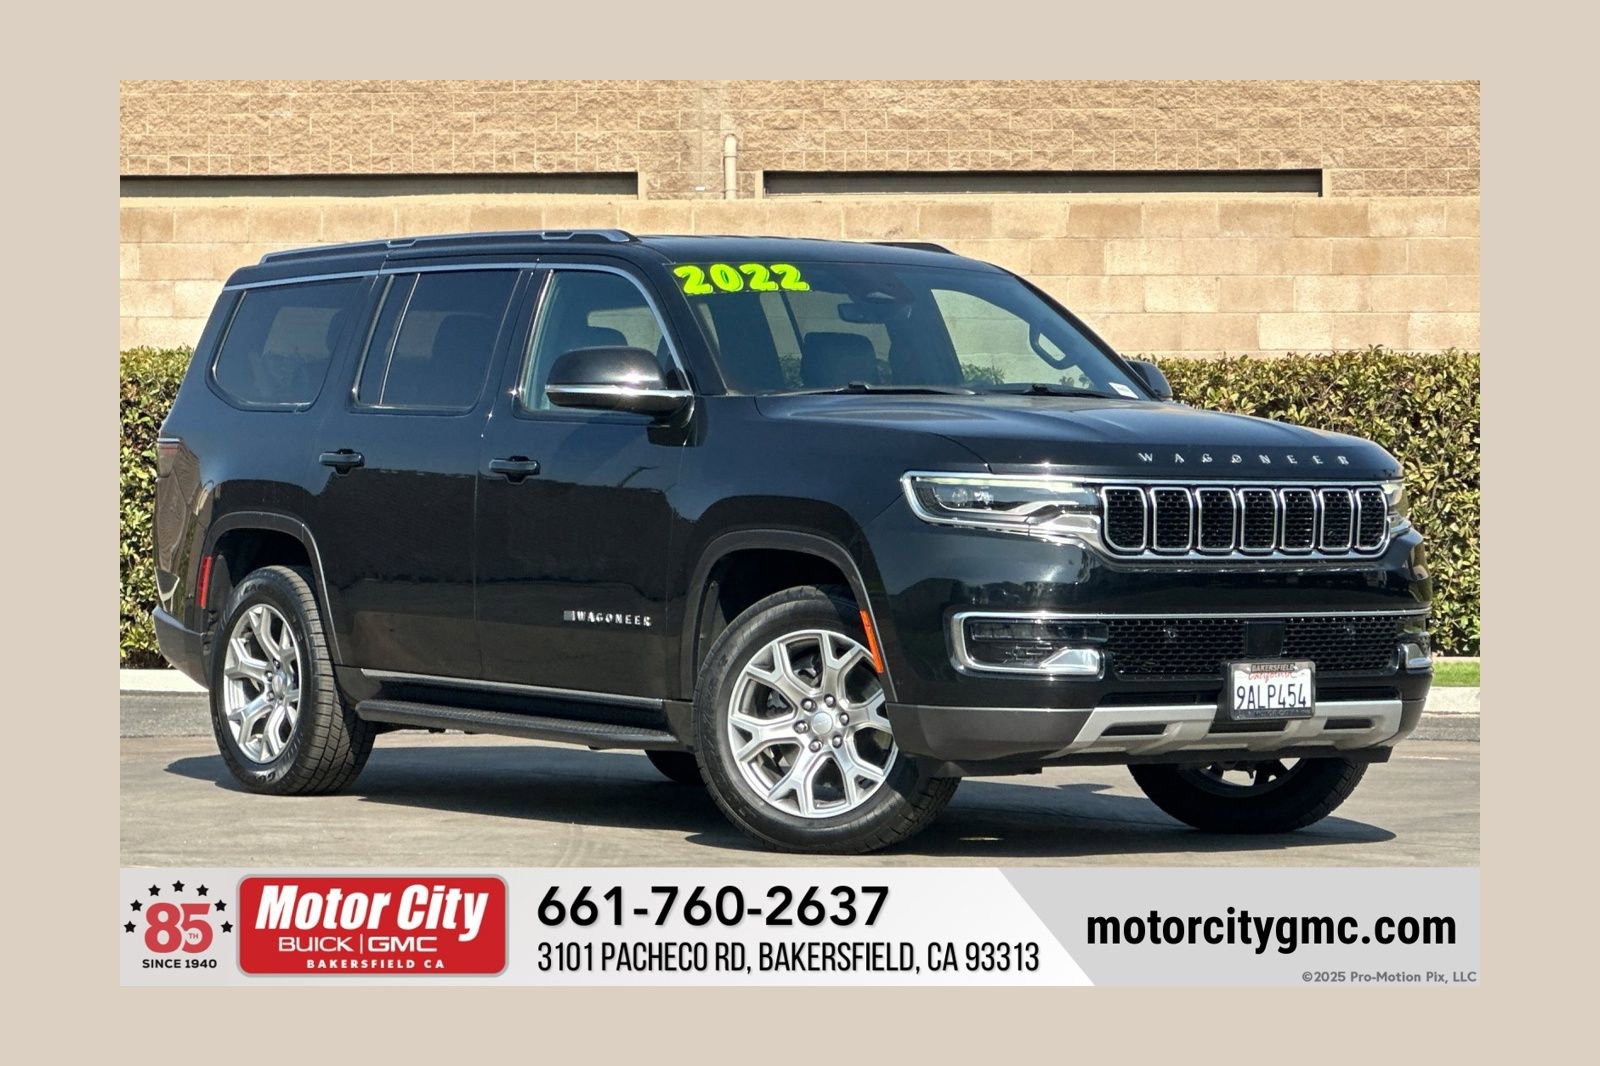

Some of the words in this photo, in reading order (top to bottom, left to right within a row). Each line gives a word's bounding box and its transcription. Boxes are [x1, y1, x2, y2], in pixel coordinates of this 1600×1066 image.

[673, 263, 811, 295] 2022
[1138, 452, 1350, 466] WAGONEER
[576, 610, 652, 627] WAGONEER
[1236, 683, 1307, 710] 9ALP454
